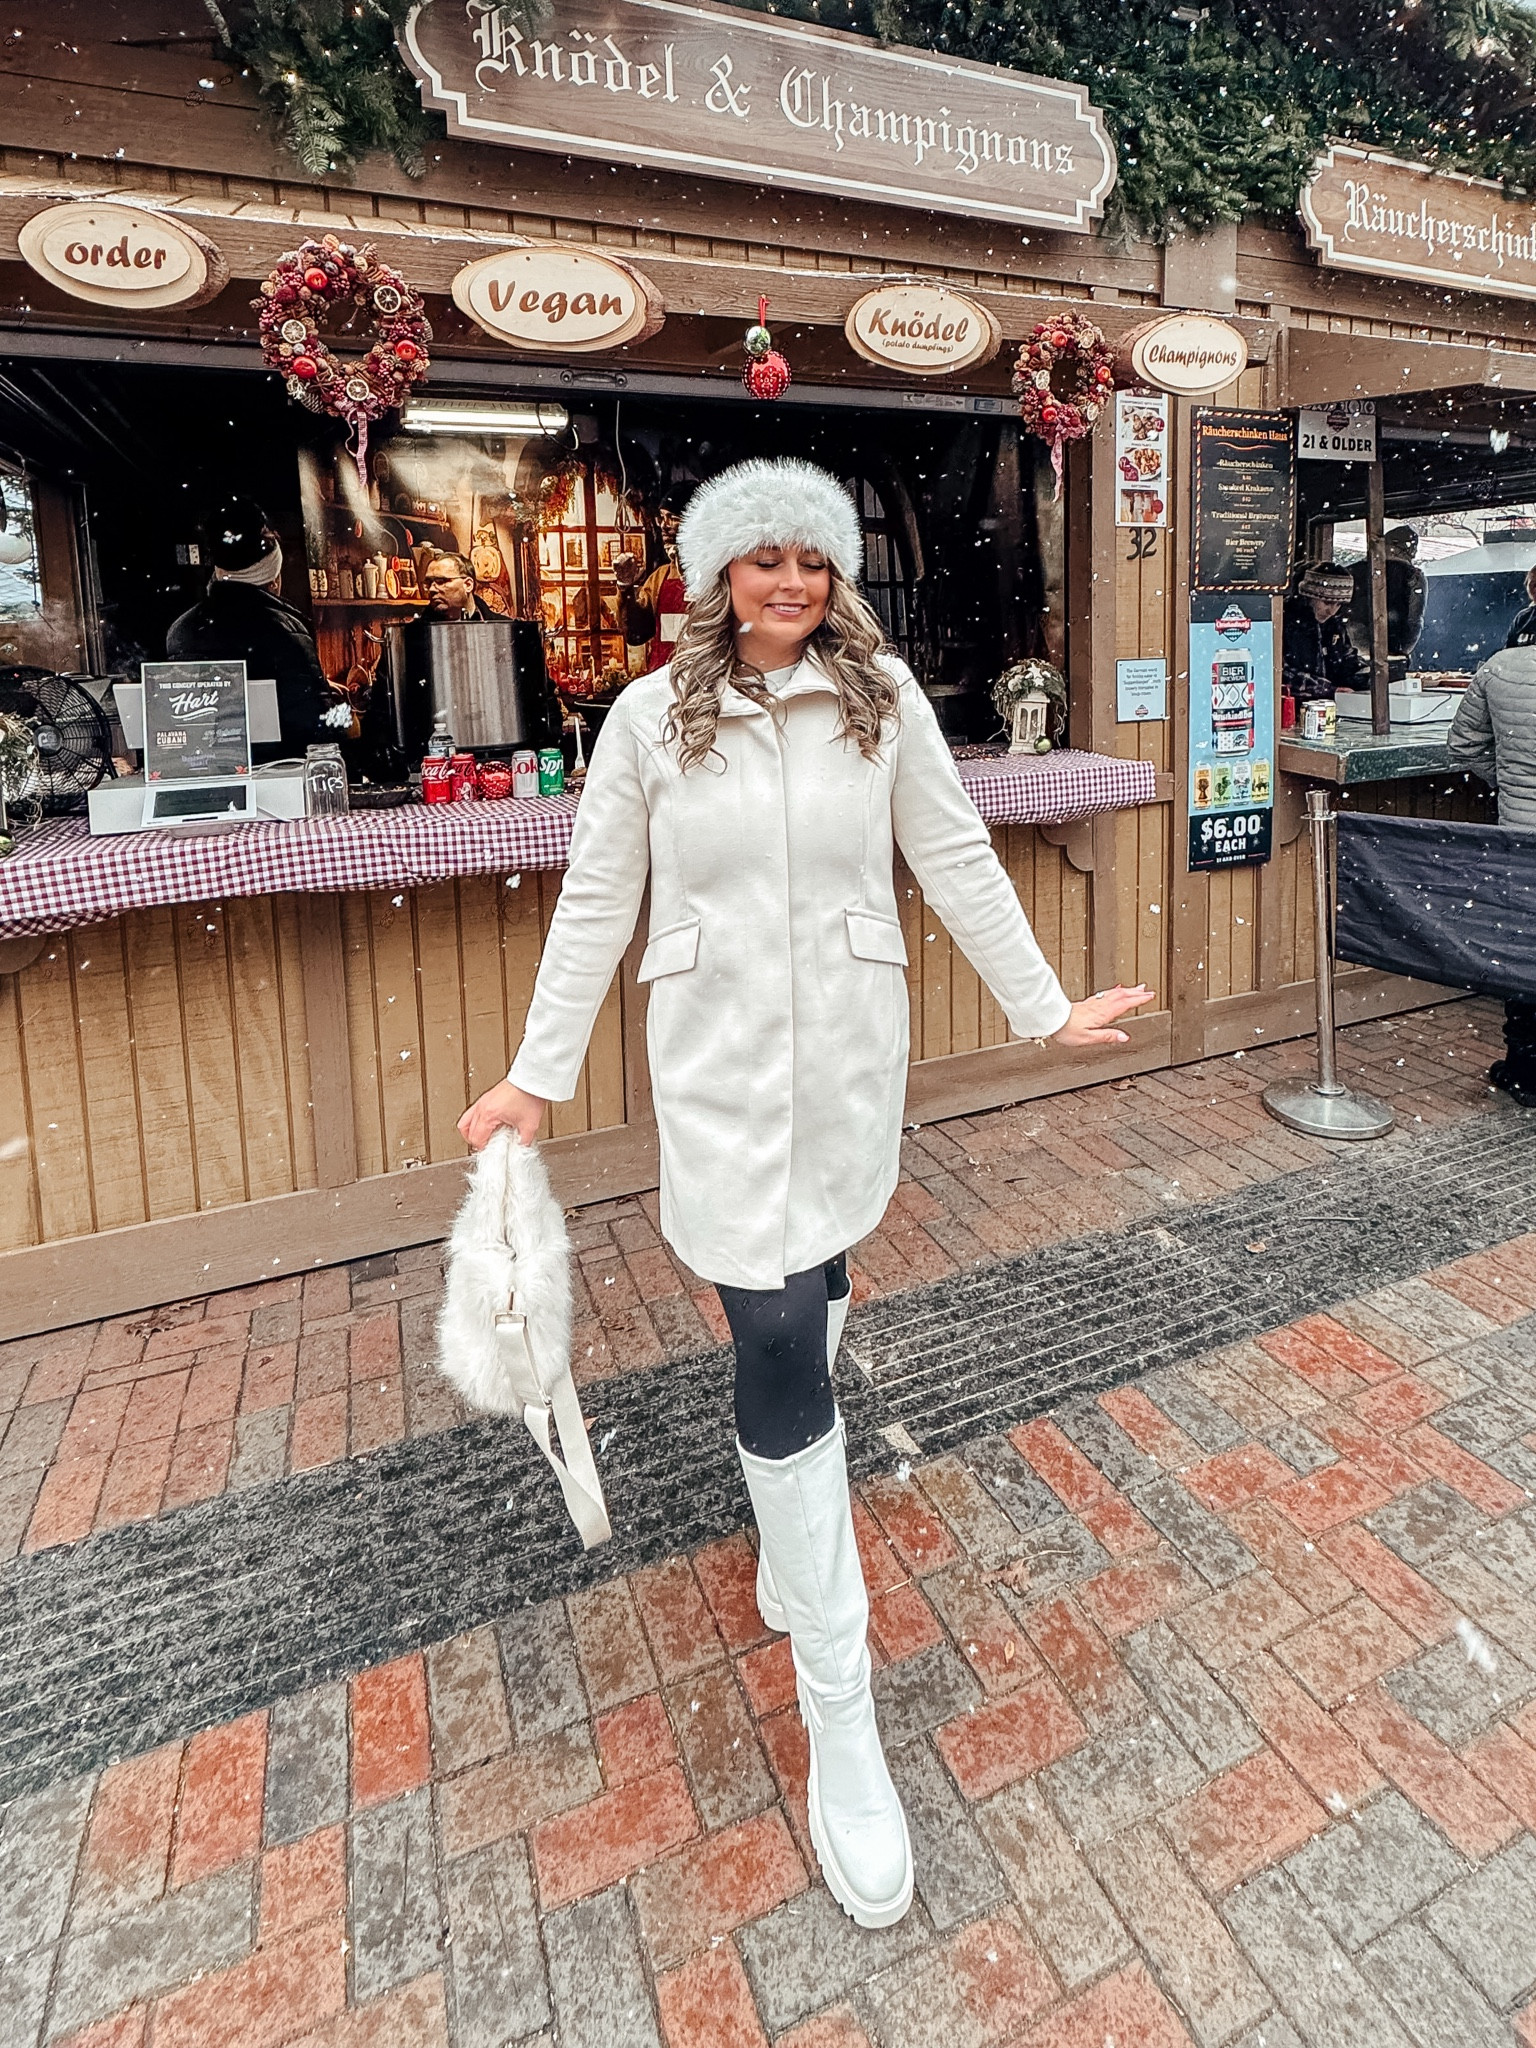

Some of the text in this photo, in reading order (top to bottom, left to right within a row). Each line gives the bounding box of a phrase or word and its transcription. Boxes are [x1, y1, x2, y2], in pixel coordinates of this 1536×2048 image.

[466, 0, 1075, 175] Knödel & Champignons
[64, 235, 167, 270] order
[488, 279, 623, 324] Vegan
[868, 307, 969, 343] Knödel
[1148, 344, 1238, 369] Champignons
[1302, 434, 1372, 452] 21 & OLDER
[1126, 527, 1157, 560] 32
[1222, 666, 1244, 676] BIER
[168, 690, 219, 715] Hart
[307, 774, 344, 793] Tips
[1200, 814, 1261, 843] $6.00
[1215, 837, 1247, 853] EACH
